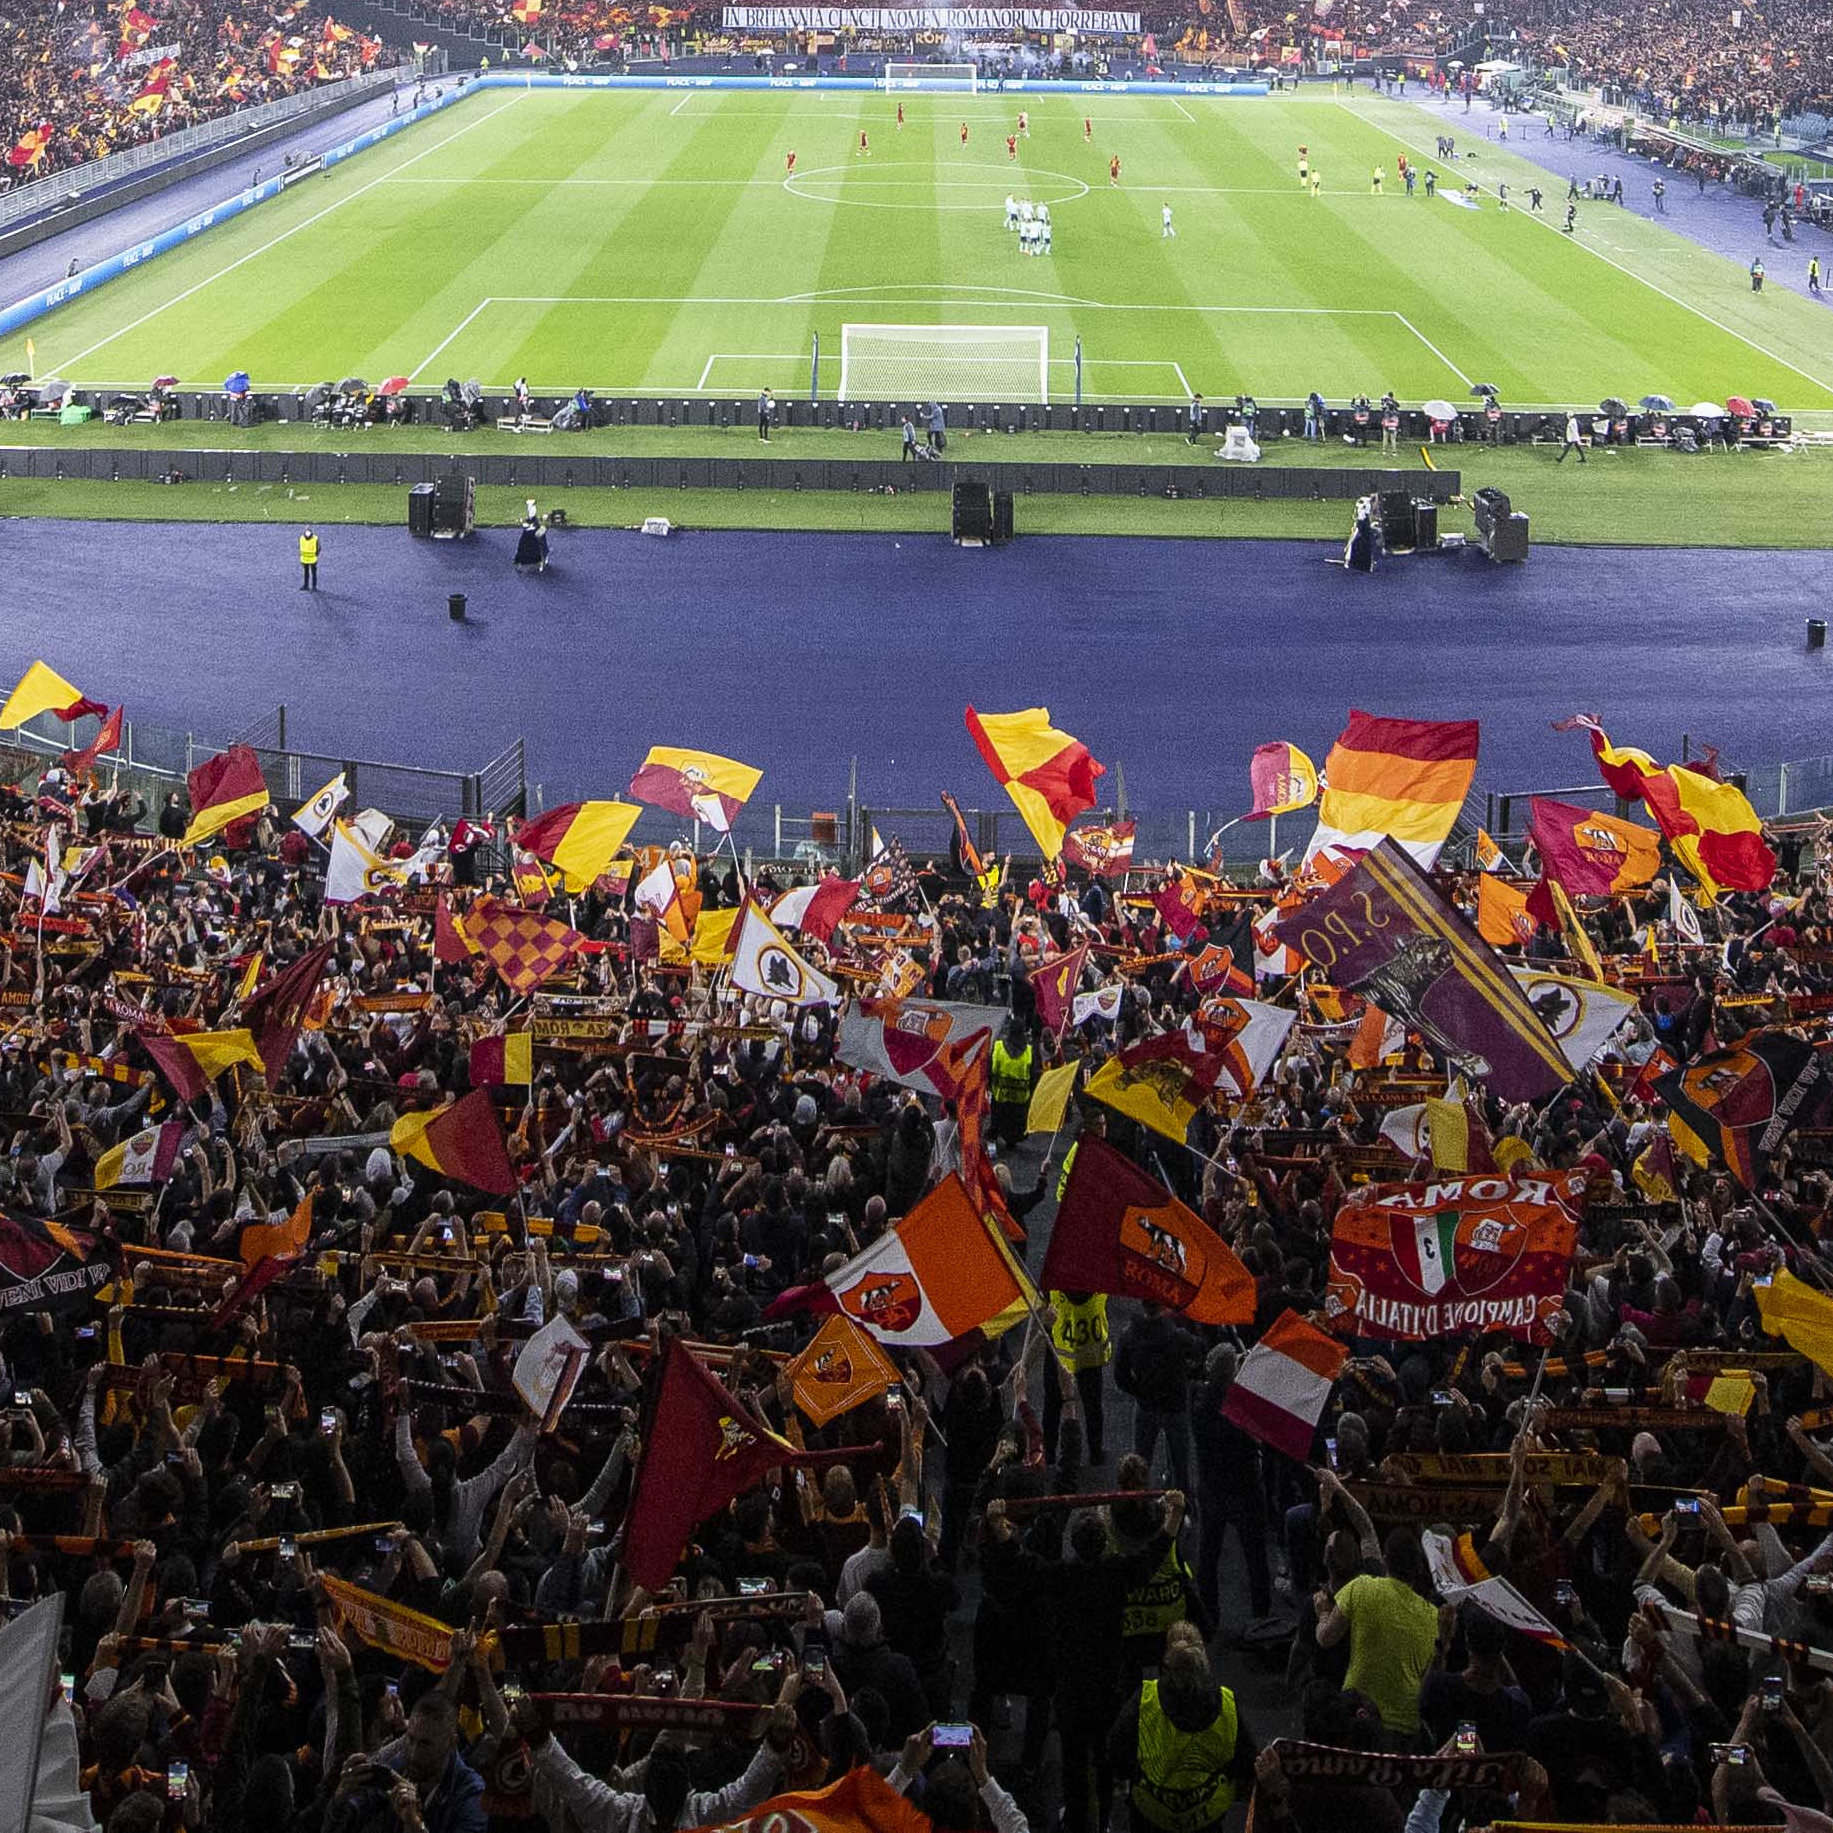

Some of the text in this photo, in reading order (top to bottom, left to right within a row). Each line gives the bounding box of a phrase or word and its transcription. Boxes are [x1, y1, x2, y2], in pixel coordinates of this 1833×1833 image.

[725, 8, 1140, 32] IN BRITANNIA CUNCTI NOMEN ROMANORUM HORREBANT
[43, 1267, 87, 1295] VIDI
[1124, 1258, 1184, 1308] ROMA
[1062, 1315, 1103, 1344] 430
